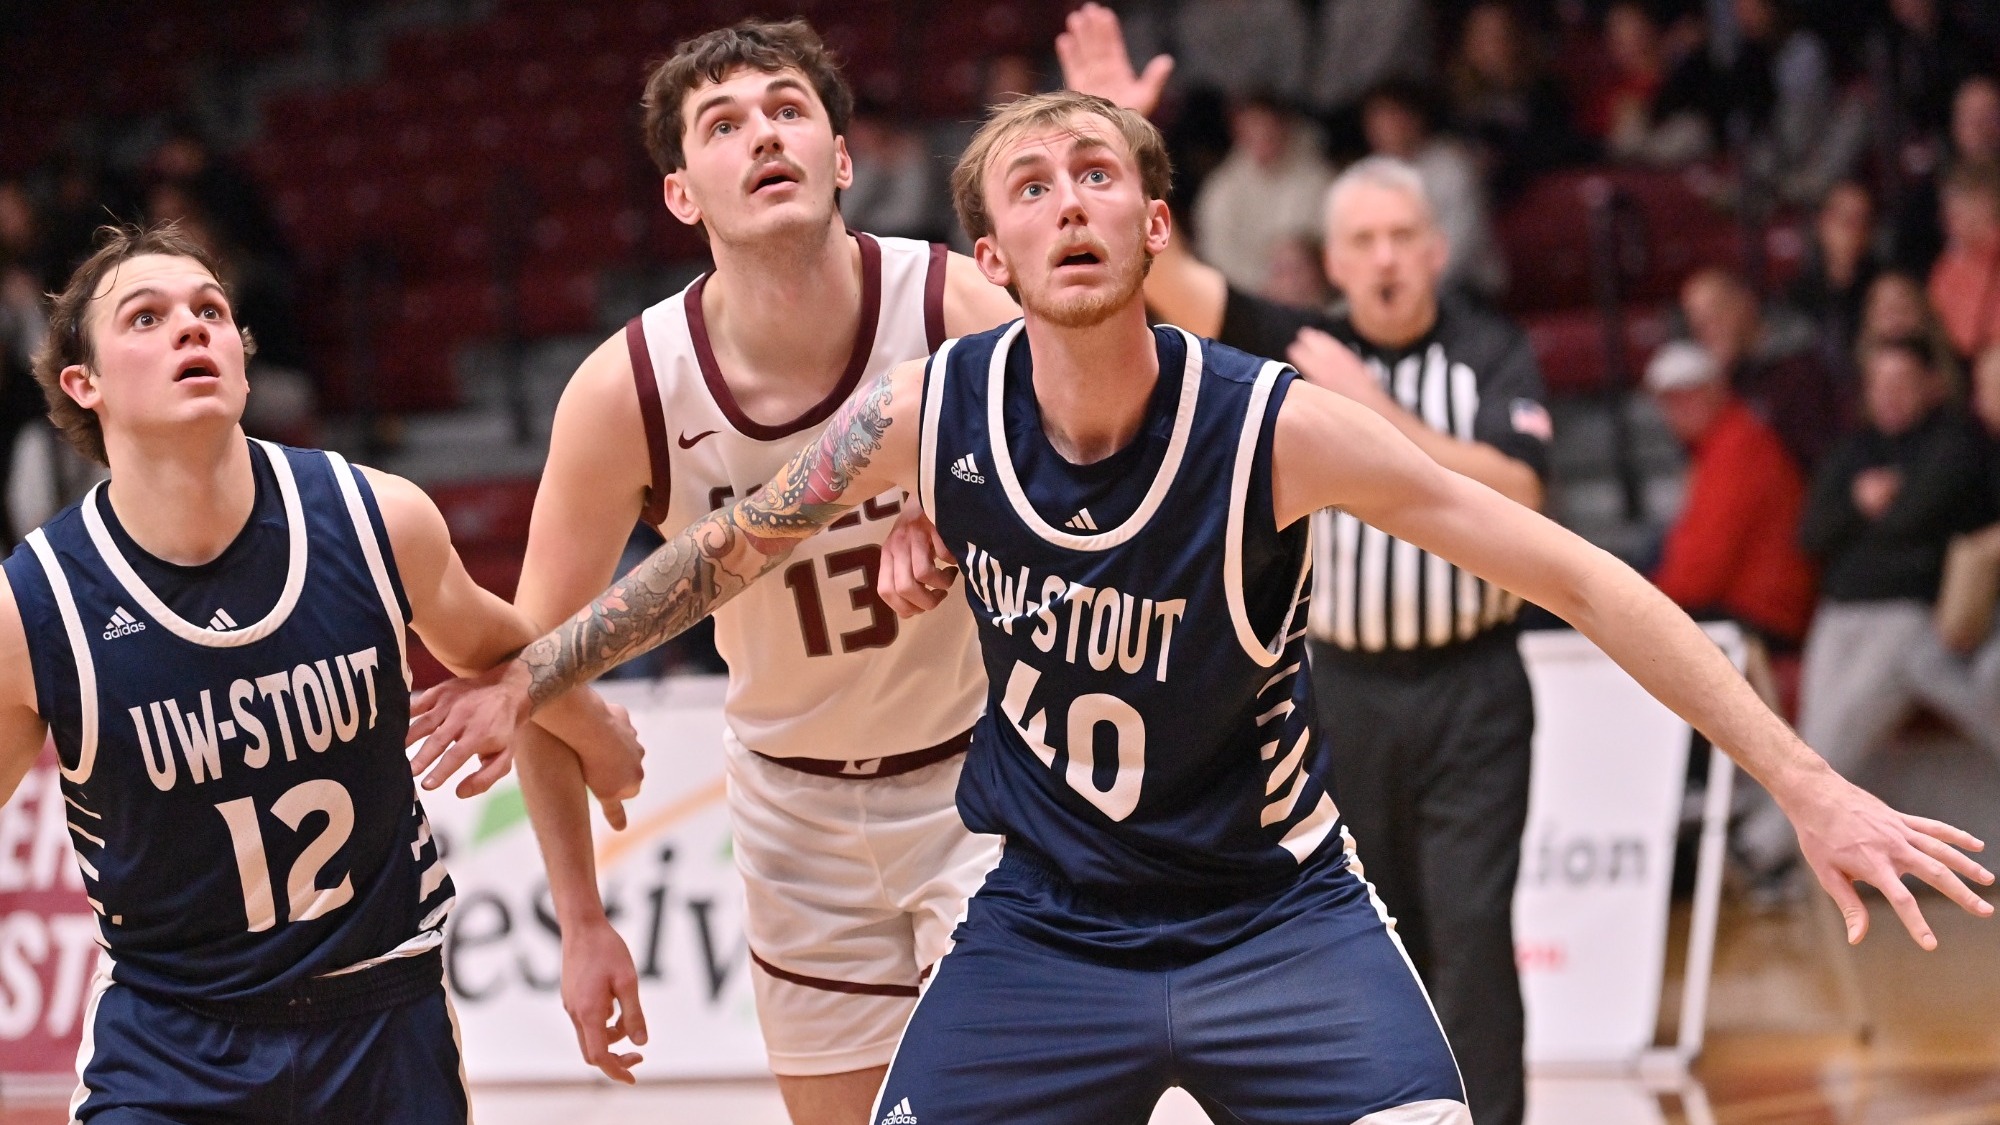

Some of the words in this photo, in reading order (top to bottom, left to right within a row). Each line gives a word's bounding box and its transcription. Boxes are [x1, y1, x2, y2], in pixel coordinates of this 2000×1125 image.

[950, 466, 985, 485] adidas
[102, 622, 146, 641] adidas
[784, 543, 900, 657] 13
[966, 541, 1187, 683] UW-STOUT
[128, 646, 379, 792] UW-STOUT
[1000, 659, 1146, 823] 40
[214, 778, 355, 933] 12
[881, 1112, 918, 1125] adidas
